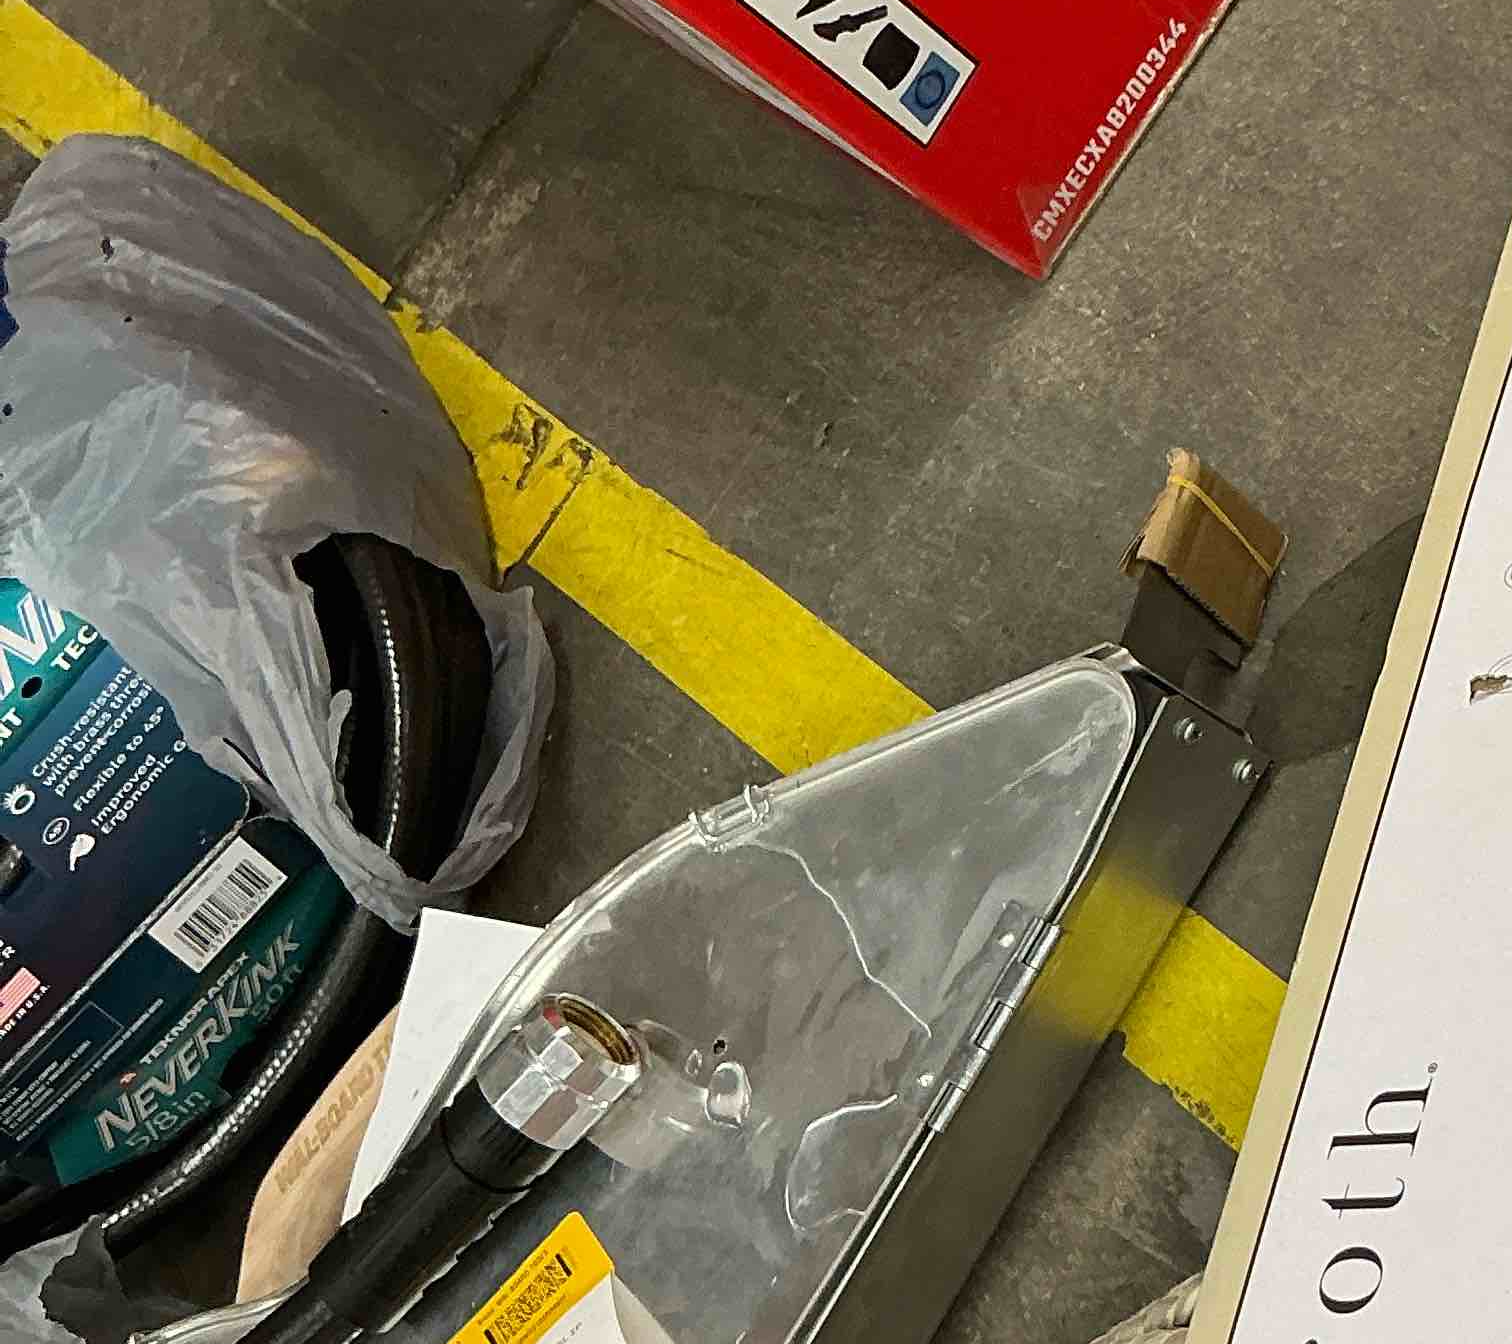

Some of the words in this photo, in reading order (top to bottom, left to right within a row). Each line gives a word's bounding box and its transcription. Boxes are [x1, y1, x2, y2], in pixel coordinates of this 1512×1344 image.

[31, 666, 132, 779] Crush-resistant
[90, 753, 161, 830] Improved
[100, 754, 174, 834] Ergonomic
